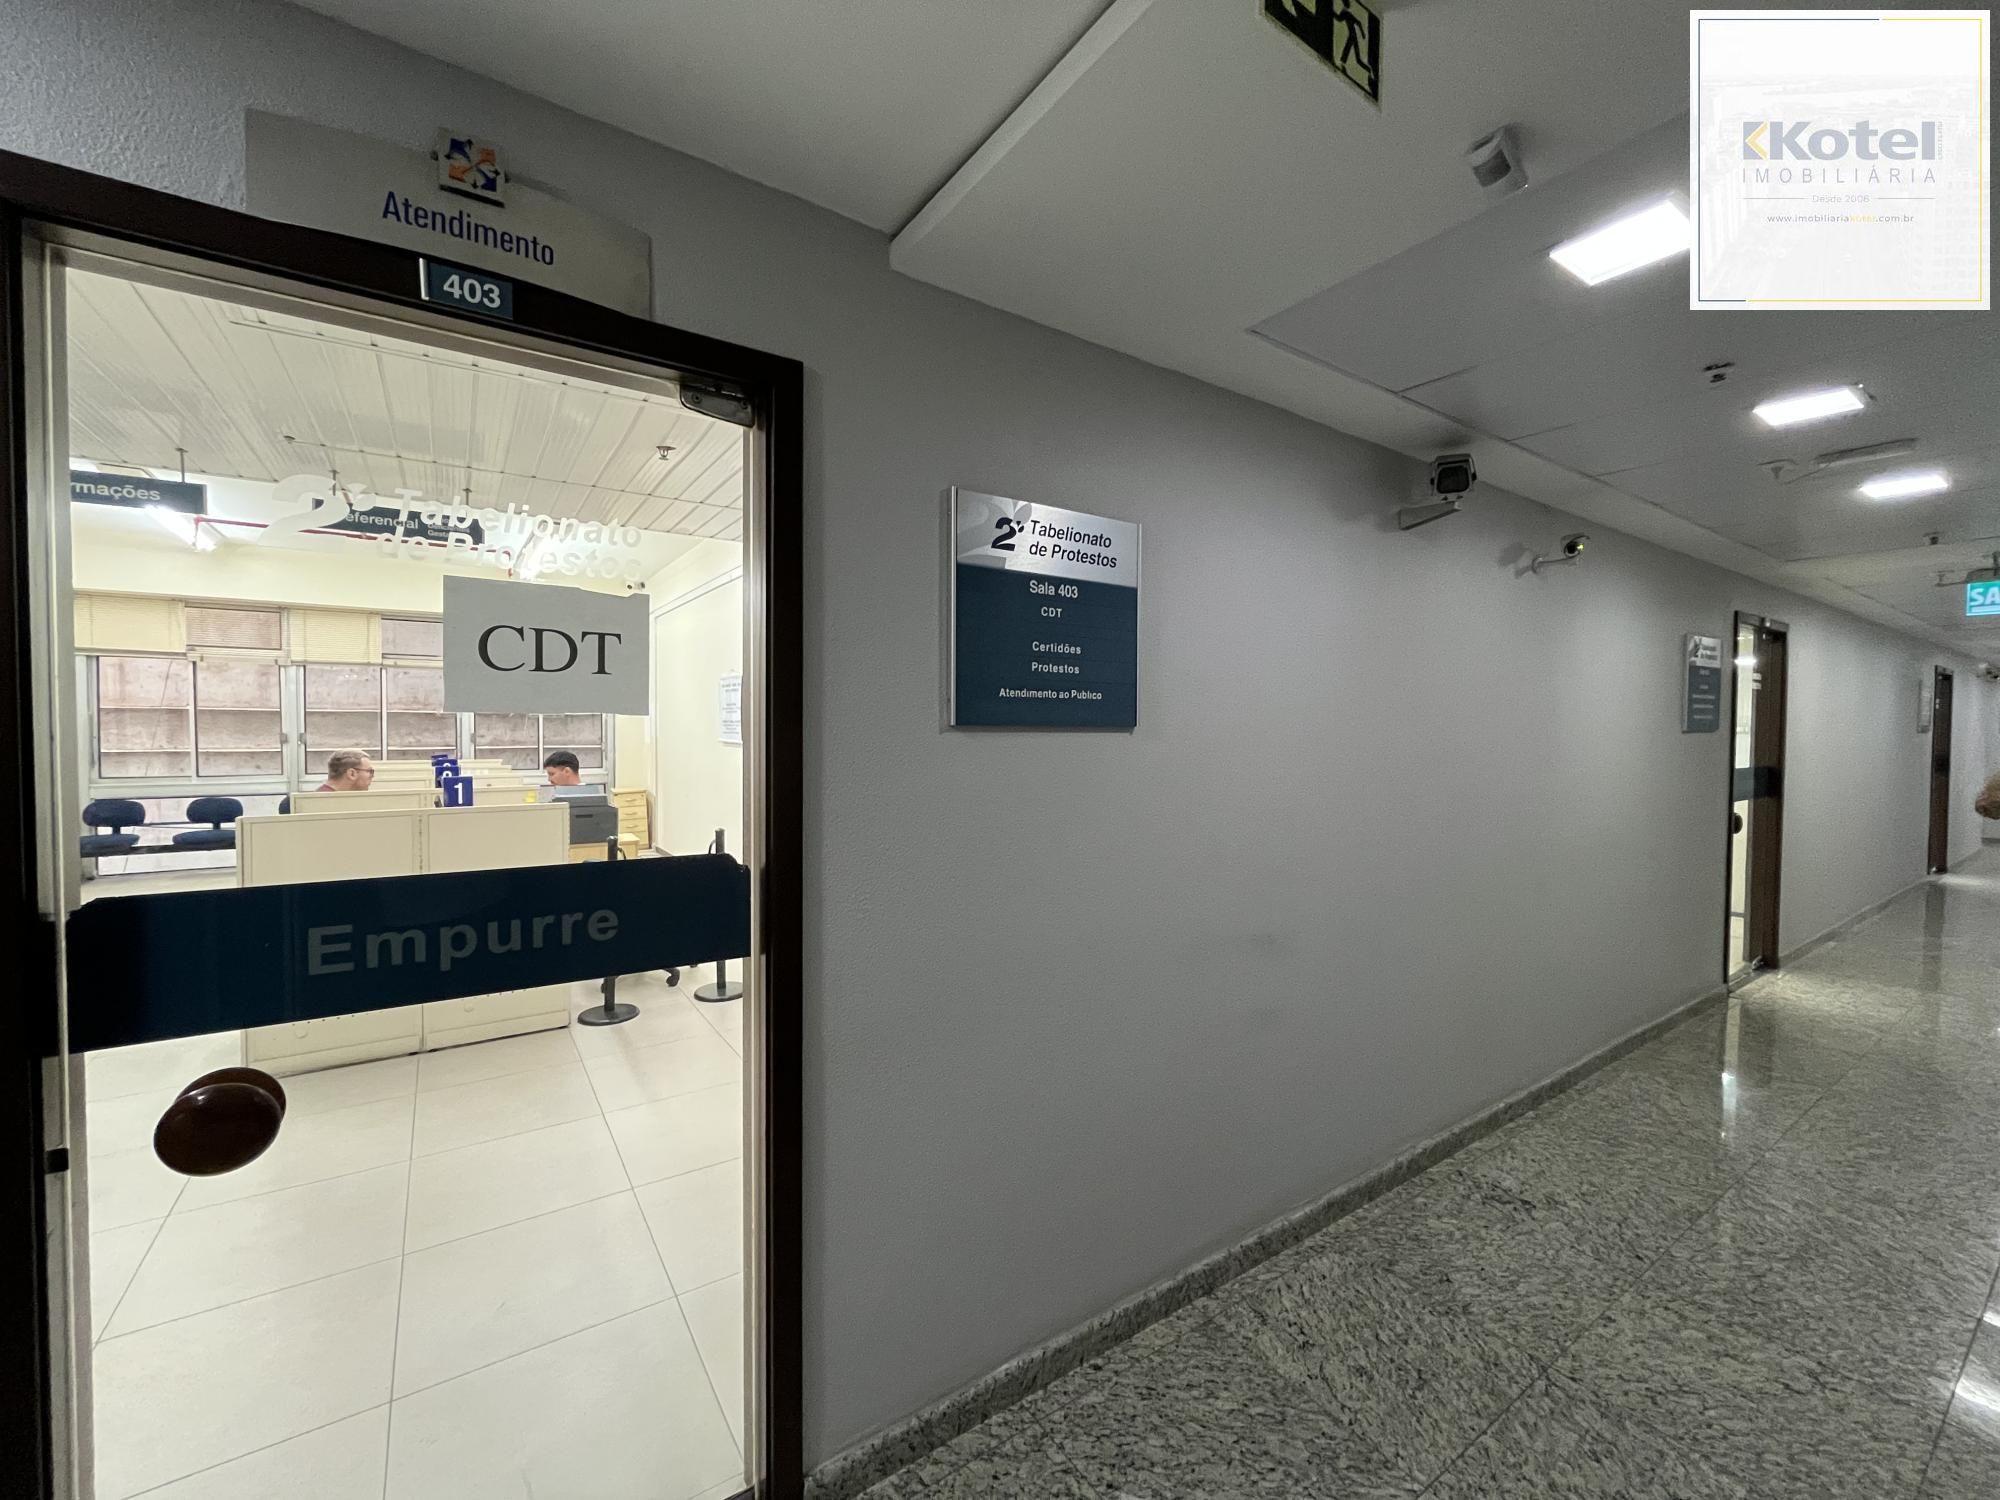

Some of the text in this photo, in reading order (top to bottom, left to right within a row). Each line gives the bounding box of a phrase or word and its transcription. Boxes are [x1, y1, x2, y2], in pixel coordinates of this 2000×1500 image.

[382, 190, 555, 266] Atendimento
[442, 274, 502, 309] 403
[394, 487, 643, 548] Tabelionato
[1030, 519, 1113, 549] Tabelionato
[446, 530, 643, 580] Proestos
[1028, 541, 1118, 569] de Protestos
[1029, 579, 1079, 599] Sala 403
[1040, 606, 1063, 619] CDT
[477, 624, 622, 675] CDT
[1031, 641, 1082, 655] Certidões
[1031, 661, 1080, 674] Protestos
[998, 687, 1058, 699] Atendimento
[1058, 691, 1070, 699] ao
[453, 782, 464, 805] 1
[307, 907, 620, 976] Empurre
